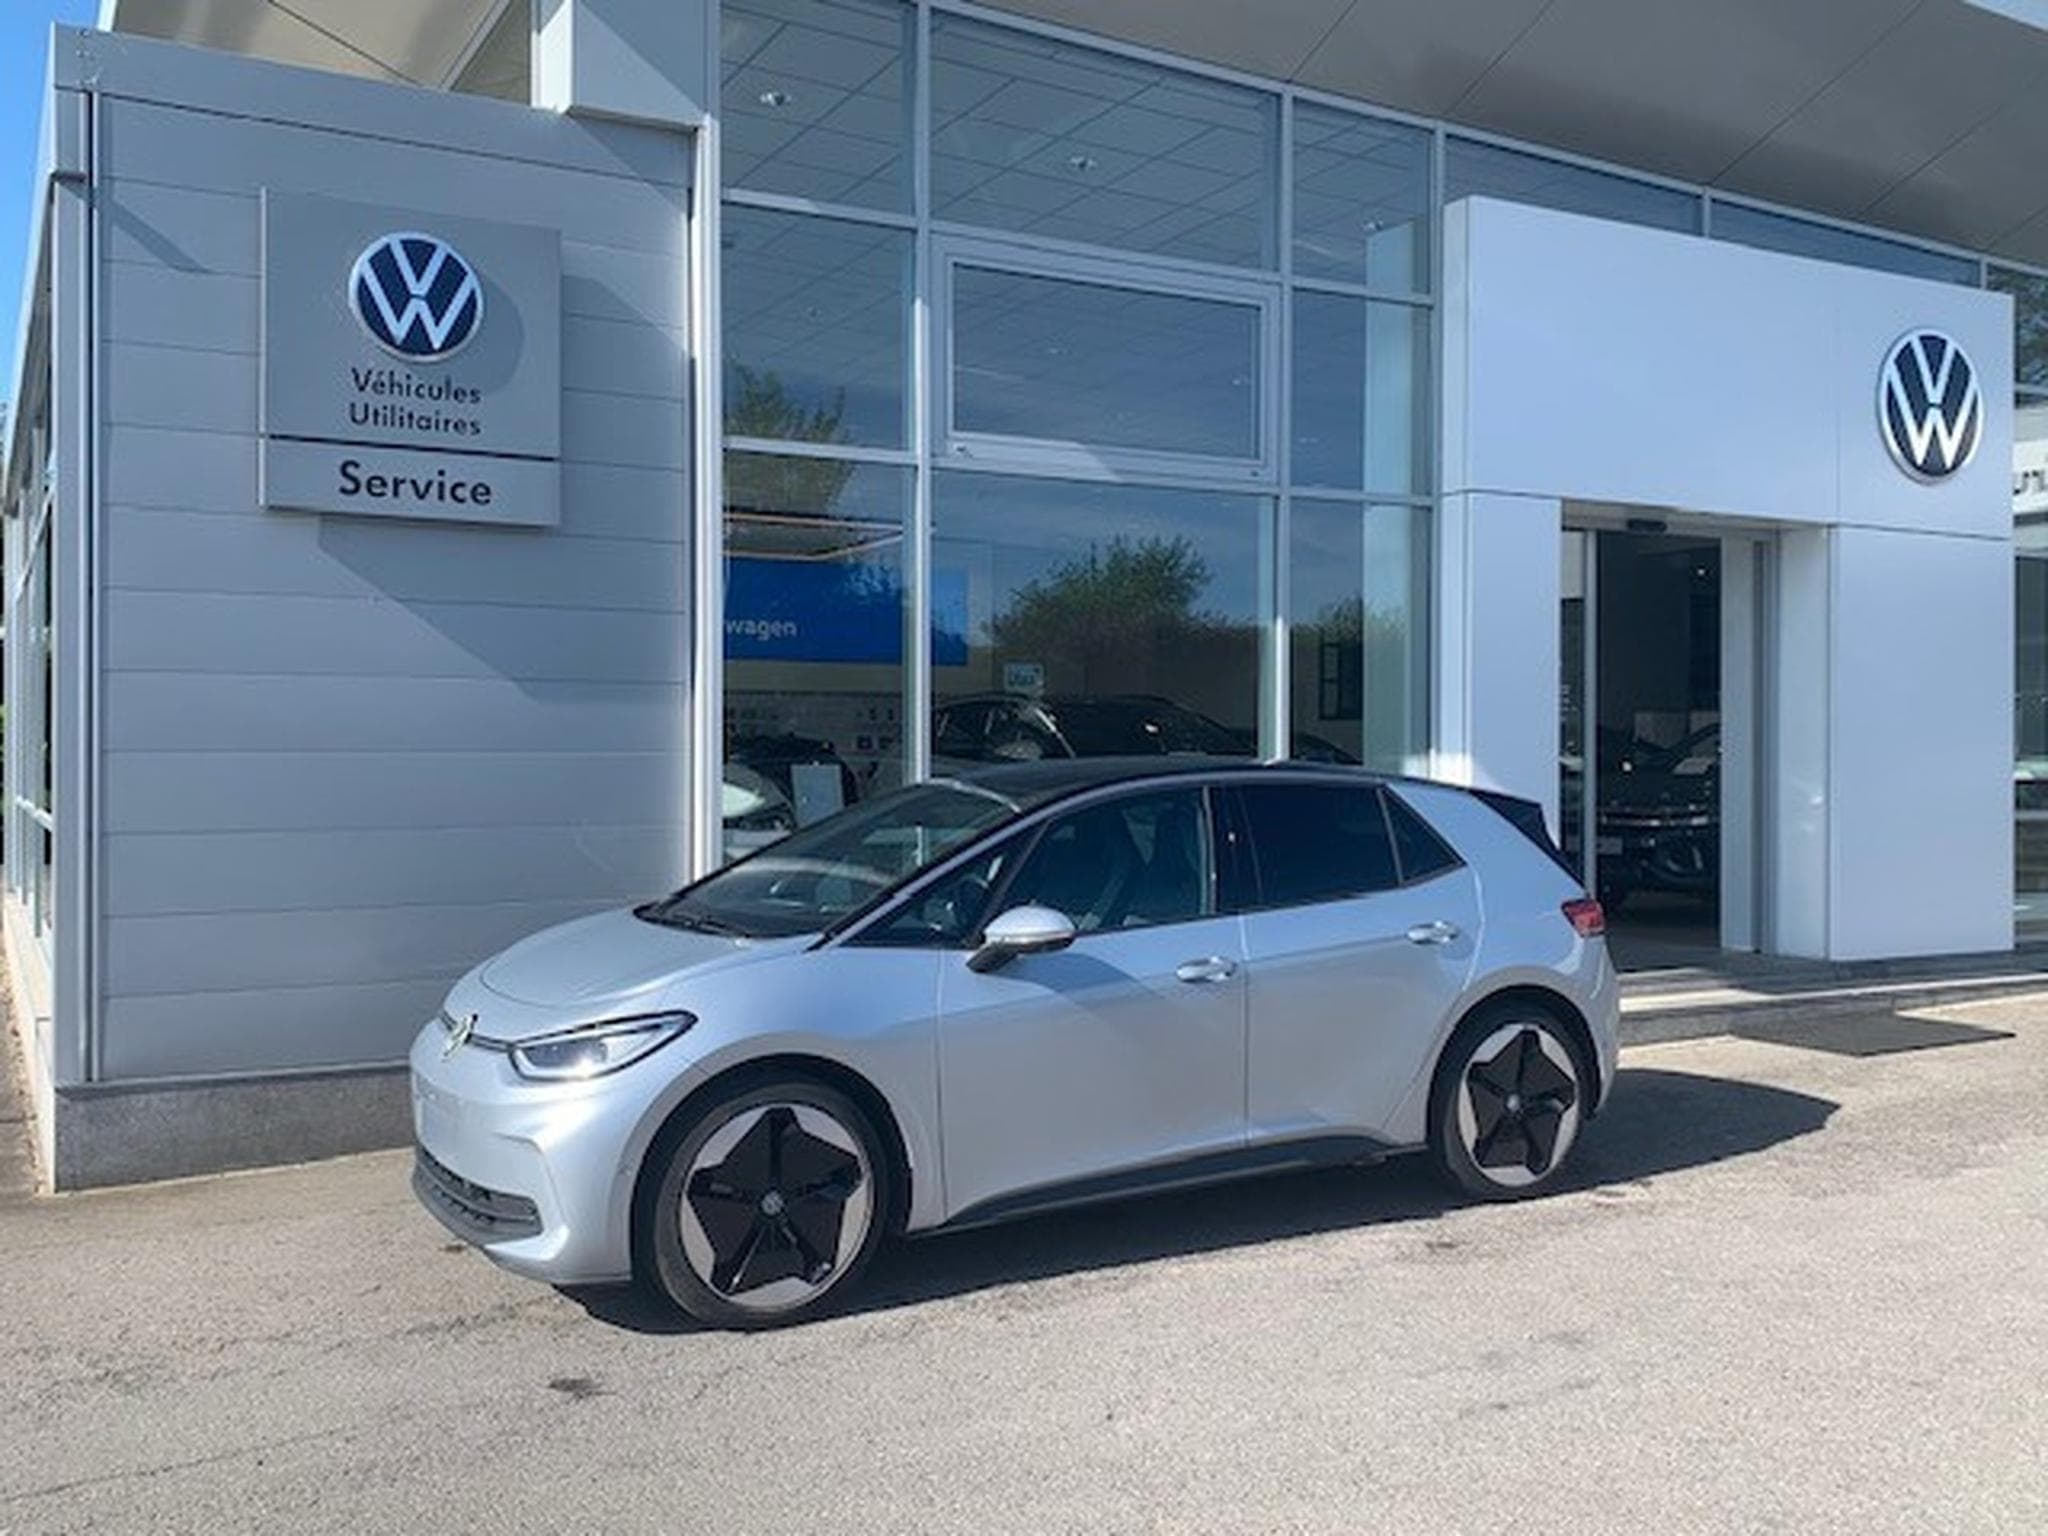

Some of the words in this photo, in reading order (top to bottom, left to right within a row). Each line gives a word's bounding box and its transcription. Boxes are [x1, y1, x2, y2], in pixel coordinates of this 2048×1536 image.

[351, 234, 481, 360] VW
[351, 366, 481, 404] Véhicules
[1881, 330, 1981, 480] VW
[350, 403, 481, 436] Utilitaires
[338, 459, 492, 506] Service
